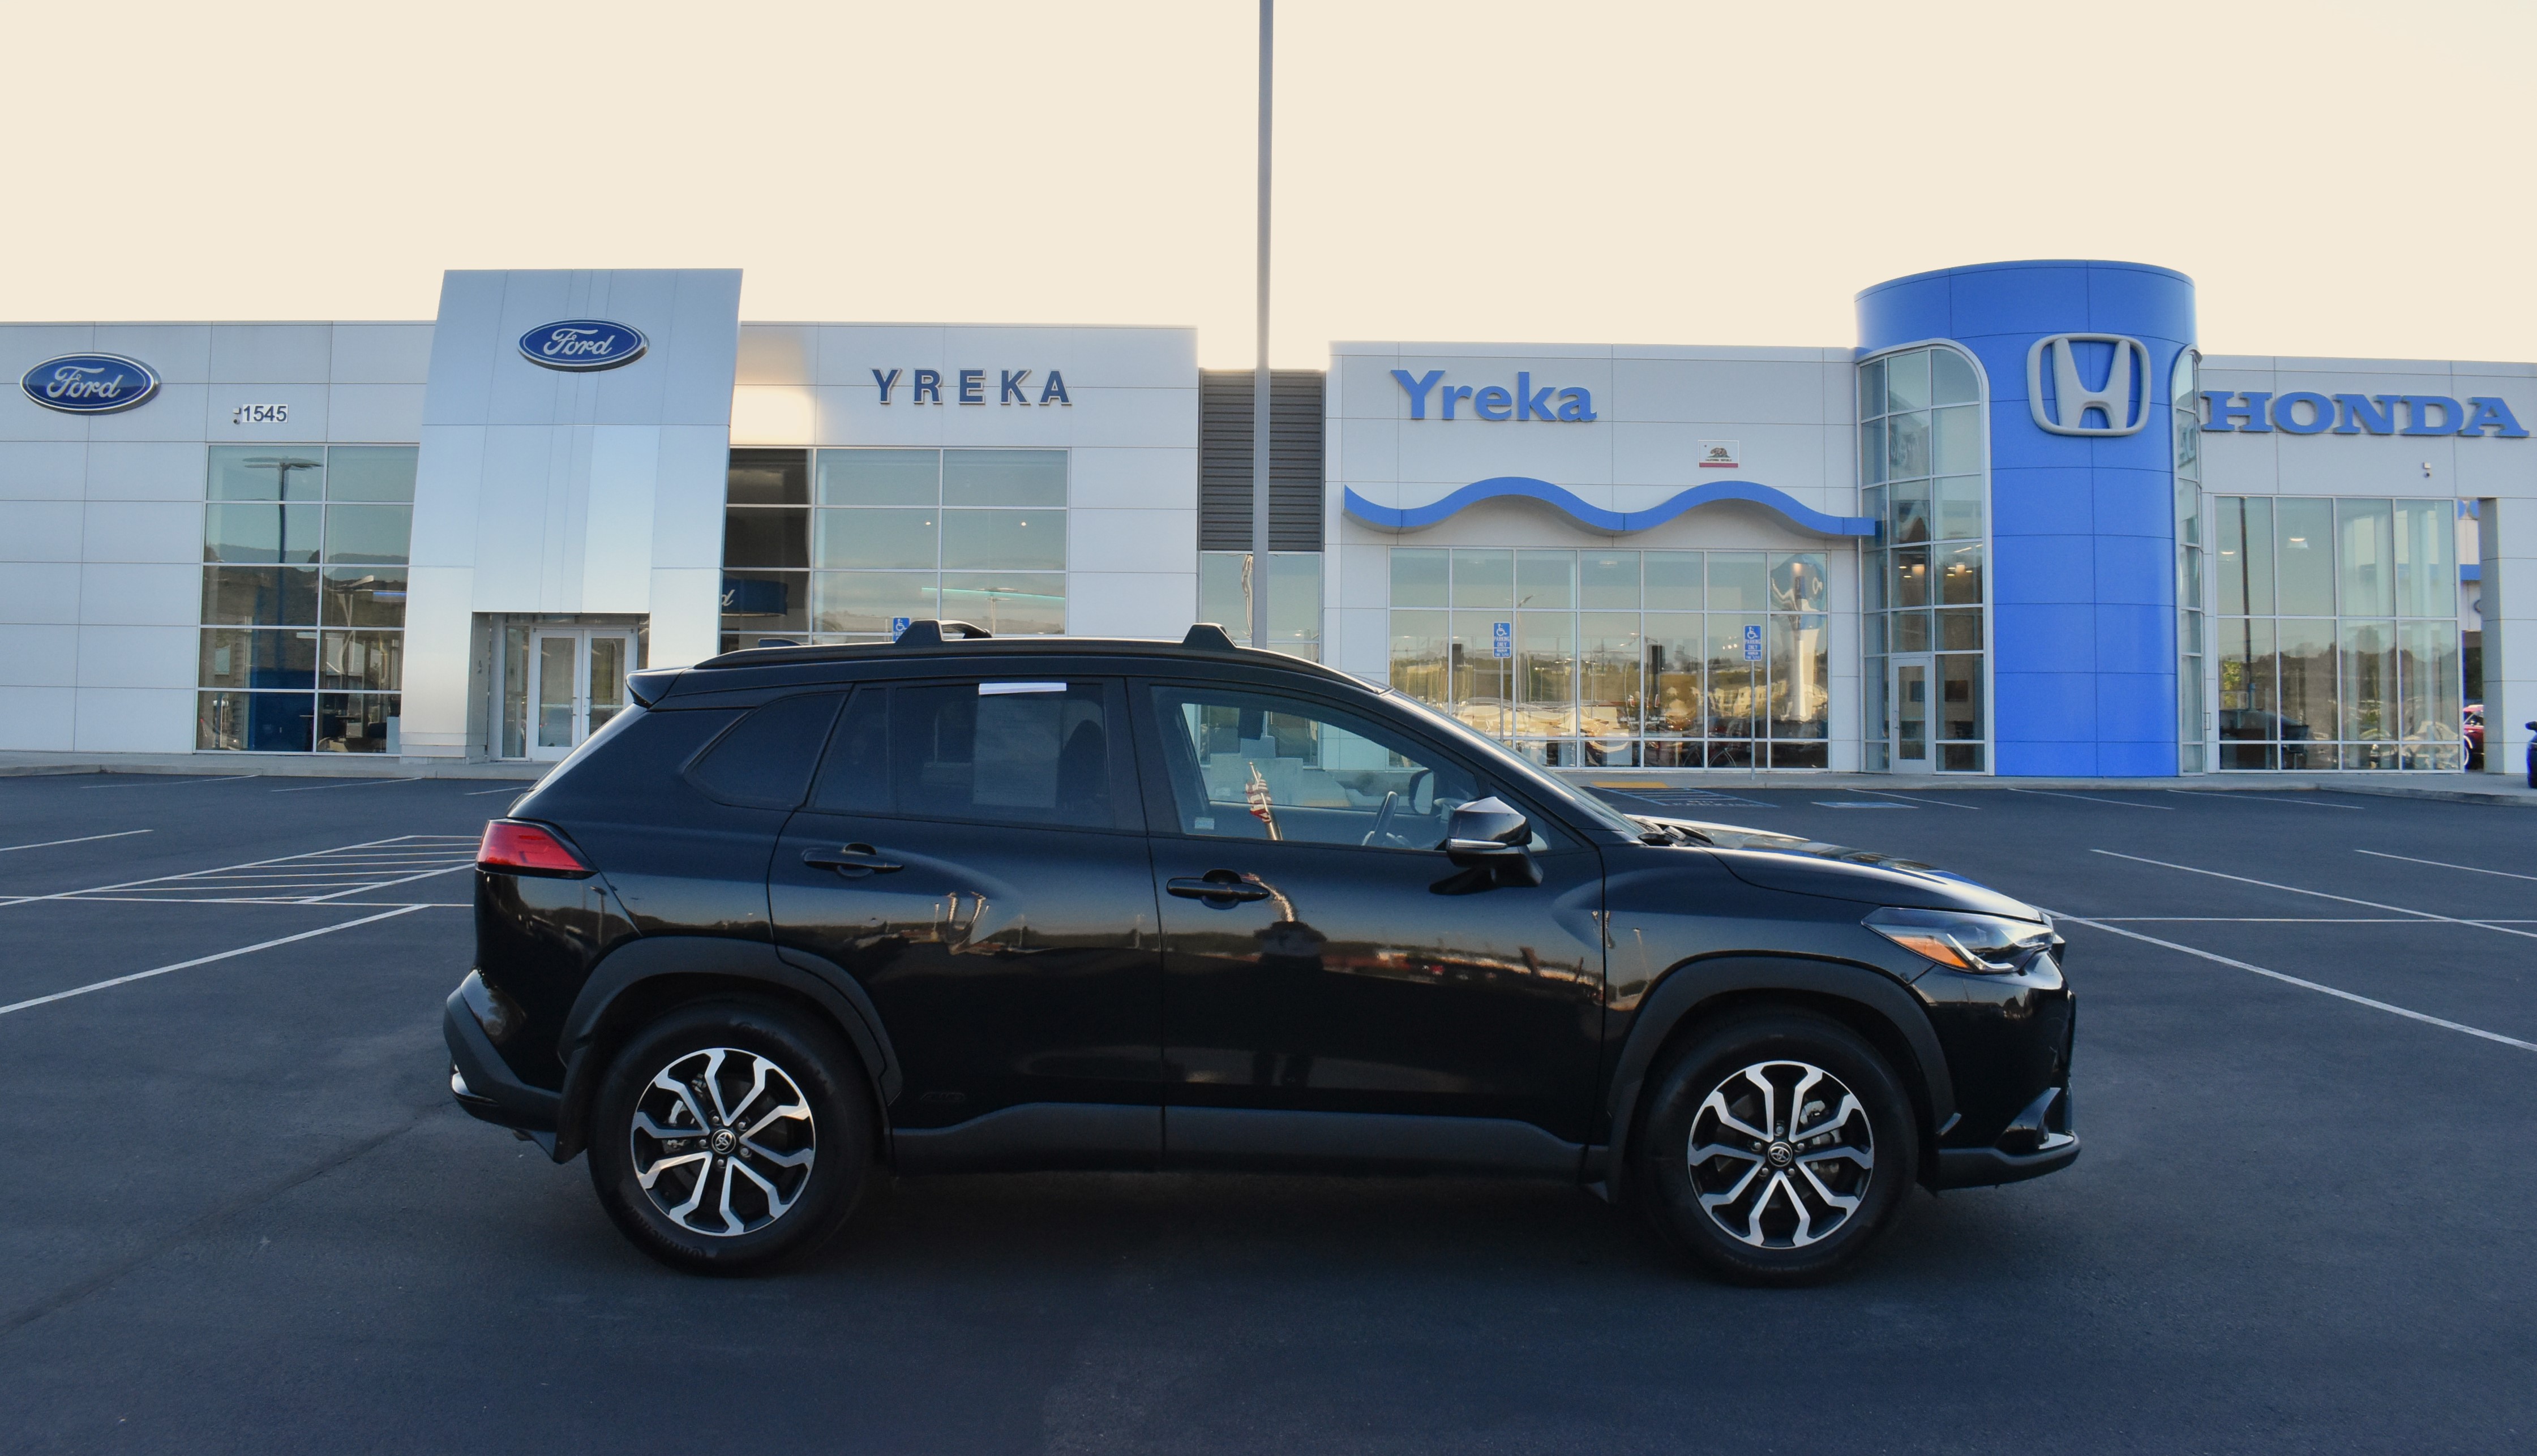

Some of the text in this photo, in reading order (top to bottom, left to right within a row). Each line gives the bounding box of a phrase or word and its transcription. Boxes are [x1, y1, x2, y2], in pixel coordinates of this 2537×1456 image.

[543, 328, 615, 355] Ford
[46, 366, 123, 398] Ford
[871, 368, 1072, 405] YREKA
[1390, 370, 1597, 422] Yreka
[243, 405, 287, 422] 1545
[2201, 390, 2529, 437] HONDA
